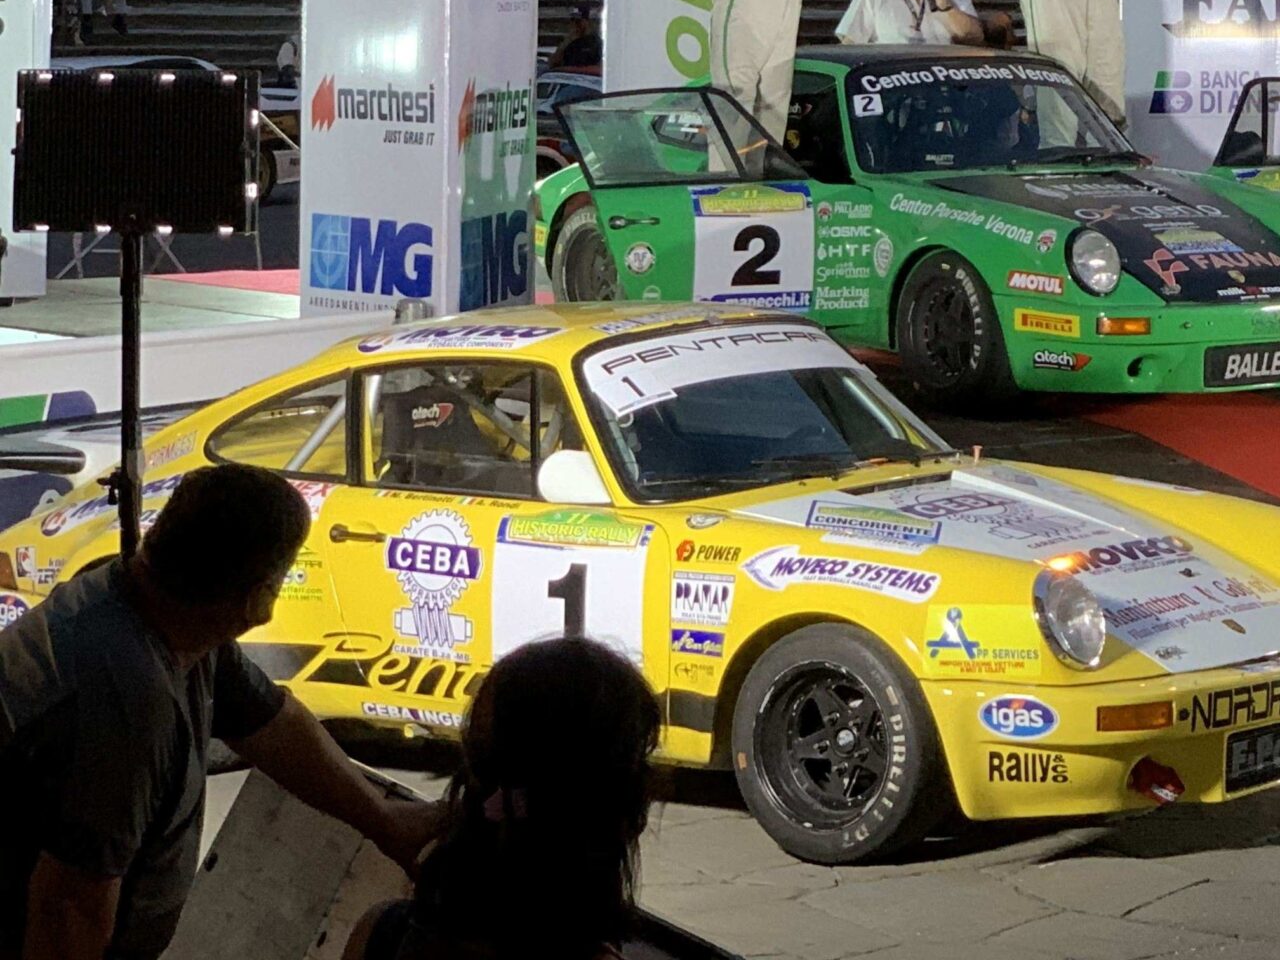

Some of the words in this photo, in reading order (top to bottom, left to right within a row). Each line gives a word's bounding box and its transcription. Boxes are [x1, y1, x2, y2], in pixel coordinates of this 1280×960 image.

[861, 69, 935, 91] Centro
[931, 64, 1012, 82] Porsche
[1008, 64, 1075, 87] Verona
[338, 83, 436, 124] marchesi
[860, 95, 876, 113] 2
[383, 130, 402, 144] JUST
[404, 130, 425, 146] GRAB
[426, 132, 436, 146] IT
[889, 193, 934, 216] Centro
[930, 203, 984, 226] Porsche
[985, 214, 1036, 245] Verona
[347, 216, 434, 299] MG
[482, 209, 529, 305] MG
[731, 224, 782, 287] 2
[816, 286, 870, 299] Marking
[1009, 273, 1063, 294] MOTUL
[725, 292, 811, 309] manecchi.it
[814, 297, 870, 310] Products
[1021, 312, 1073, 333] PIRELLI
[1034, 350, 1075, 366] atech
[621, 376, 645, 398] 1
[514, 519, 586, 538] HISTORIC
[588, 525, 639, 543] RALLY
[814, 515, 933, 536] CONCORRENTE
[395, 541, 471, 576] CEBA
[696, 544, 742, 562] POWER
[769, 557, 849, 577] MOVECO
[849, 563, 939, 594] SYSTEMS
[547, 563, 588, 640] 1
[675, 581, 730, 614] PRAMAR
[992, 648, 1040, 660] SERVICES
[363, 702, 415, 721] CEBA
[991, 703, 1045, 734] igas
[988, 750, 1051, 784] Rally
